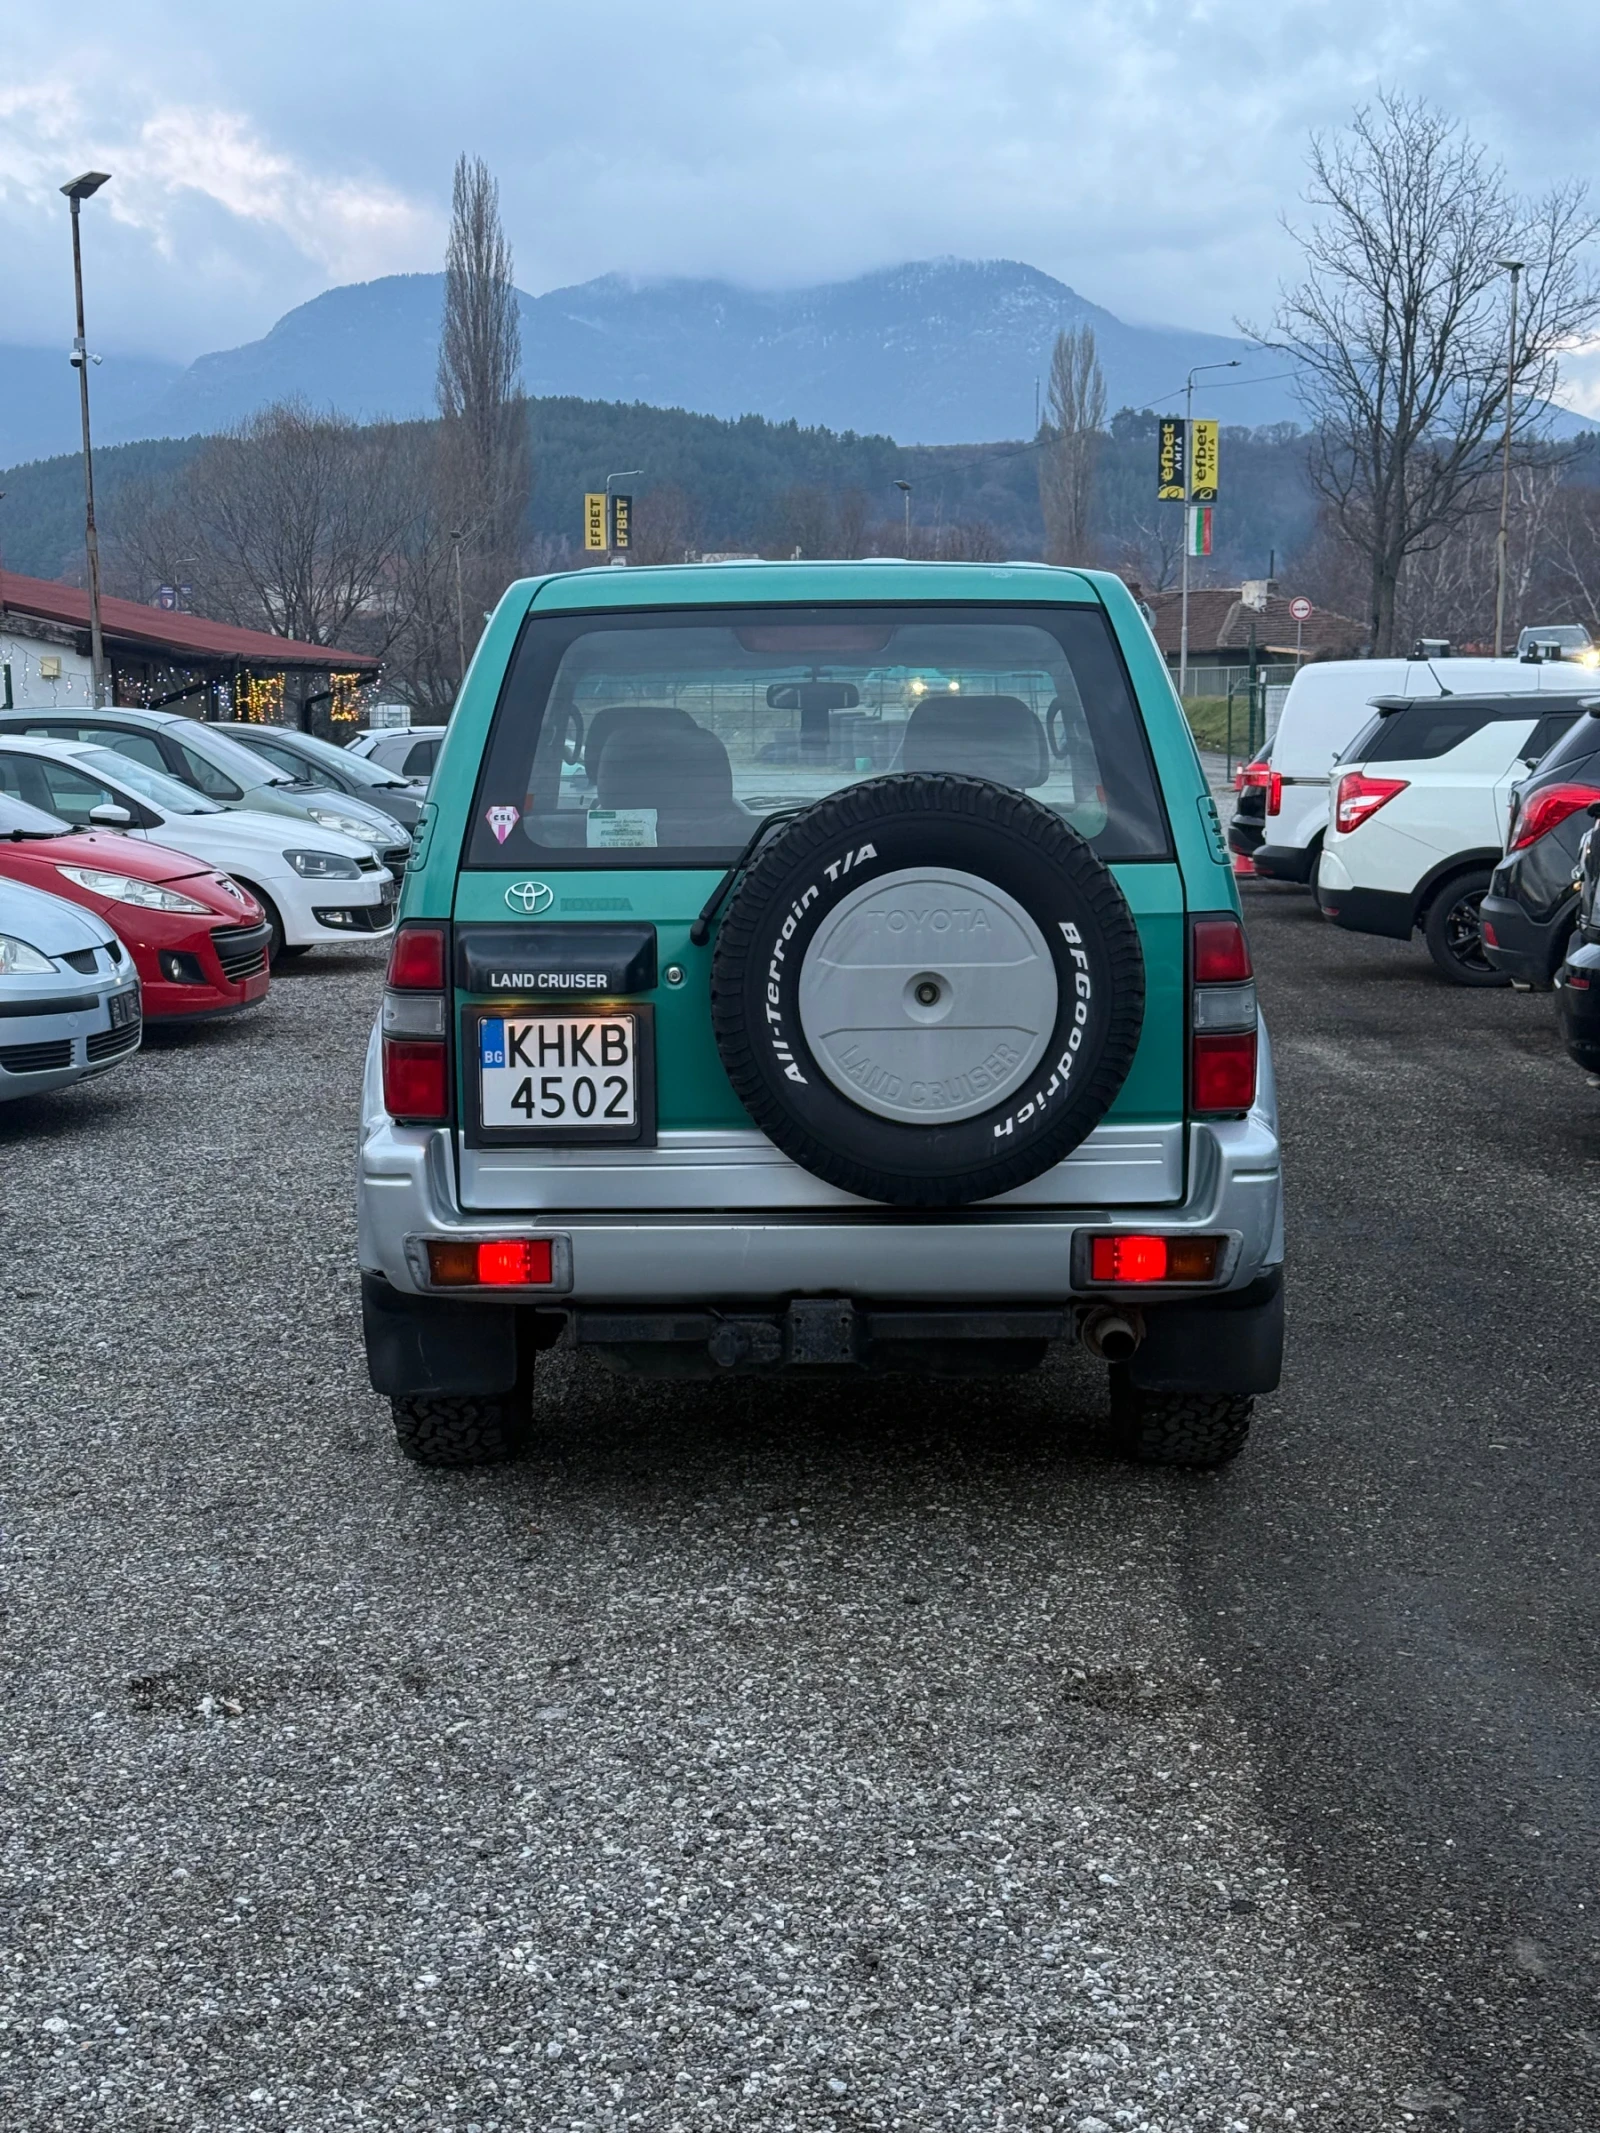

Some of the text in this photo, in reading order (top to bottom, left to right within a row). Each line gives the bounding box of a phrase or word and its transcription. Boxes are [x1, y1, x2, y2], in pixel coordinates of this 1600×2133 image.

[1161, 423, 1175, 482] efbet
[1195, 424, 1207, 483] efbet
[590, 498, 601, 546] EFBET
[616, 498, 628, 547] EFBET
[866, 908, 992, 934] TOYOTA
[491, 973, 608, 989] LAND CRUISER
[766, 843, 878, 1085] All-Terrain T/A
[993, 922, 1092, 1138] BFGoodrich
[484, 1051, 503, 1064] BG
[838, 1043, 1020, 1107] LAND CRUISER
[510, 1075, 629, 1119] 4502
